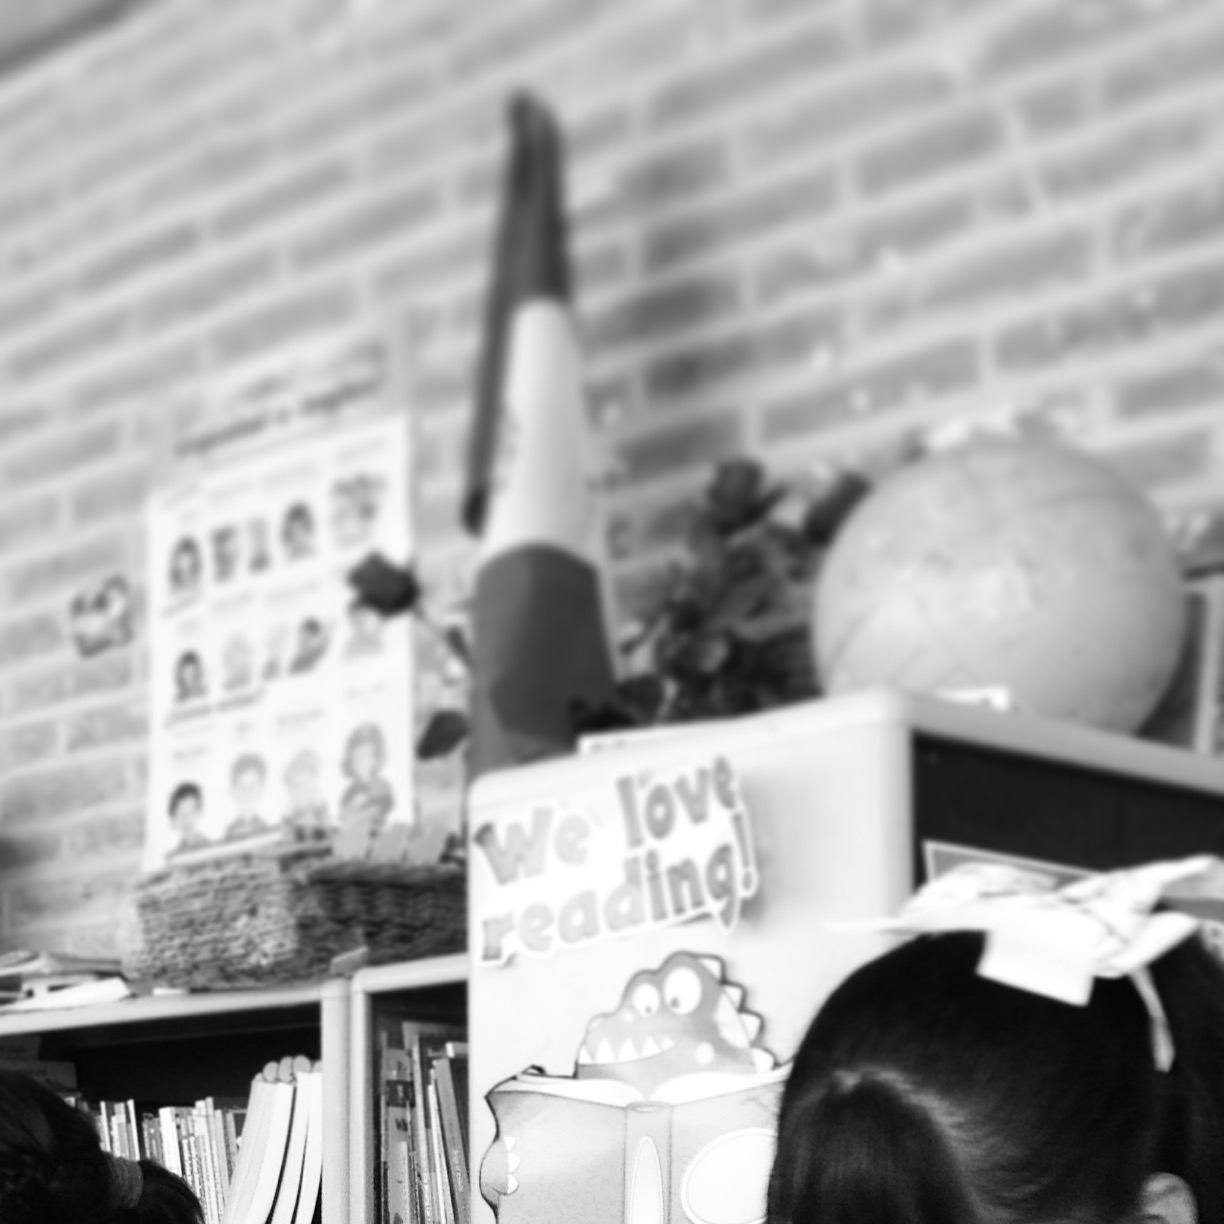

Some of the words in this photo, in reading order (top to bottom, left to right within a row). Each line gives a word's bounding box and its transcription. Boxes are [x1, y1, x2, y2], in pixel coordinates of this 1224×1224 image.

[474, 805, 591, 887] We
[616, 755, 737, 849] love
[481, 812, 755, 961] reading!
